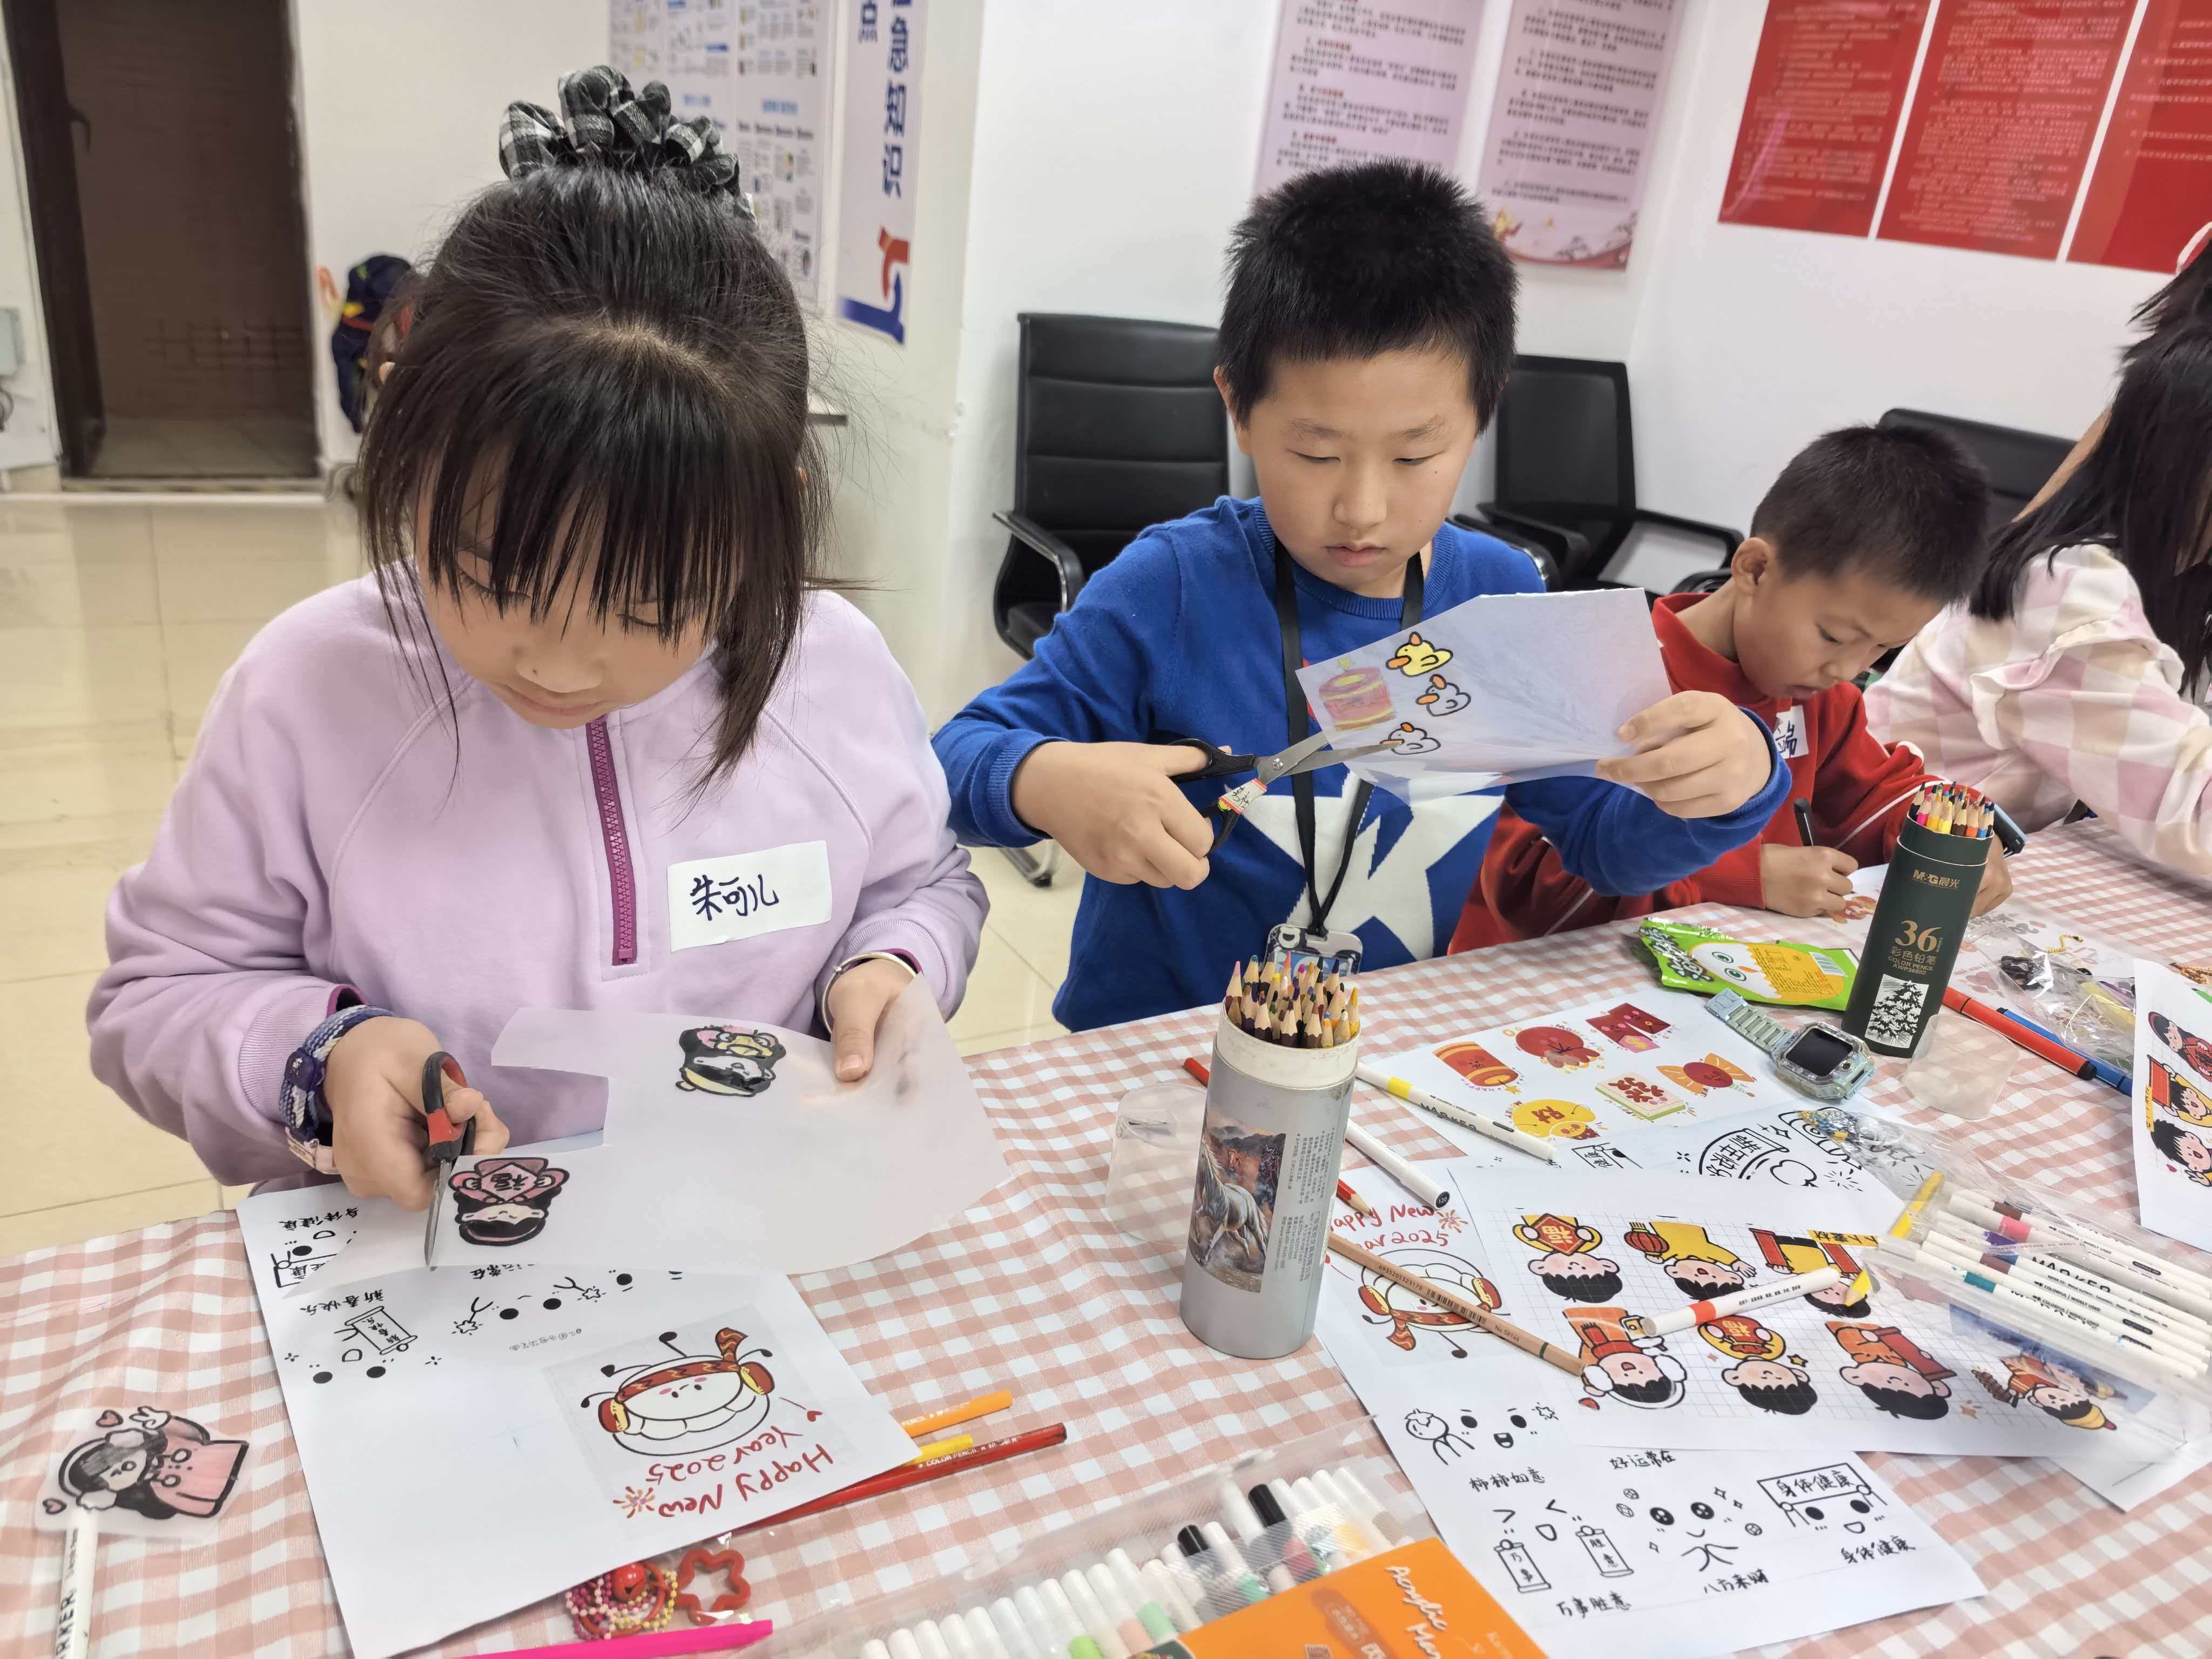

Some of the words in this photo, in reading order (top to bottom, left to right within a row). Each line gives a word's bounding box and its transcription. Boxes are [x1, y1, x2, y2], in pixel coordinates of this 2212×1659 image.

[690, 874, 779, 921] 朱可儿
[1895, 920, 1943, 953] 36
[1887, 955, 1911, 967] COLOR
[1910, 961, 1934, 972] PENCIL
[1890, 945, 1937, 966] 彩色铅笔
[1706, 1135, 1762, 1178] 新年快乐
[490, 1172, 529, 1191] 福
[1439, 1196, 1448, 1204] 120
[278, 1207, 358, 1230] 身体健康
[1331, 1207, 1381, 1232] appy
[1391, 1205, 1434, 1222] New
[1392, 1230, 1448, 1247] 2025
[1541, 1225, 1573, 1244] 福
[470, 1263, 535, 1280] 运常在
[300, 1288, 384, 1316] 新春快乐
[733, 1425, 804, 1464] Year
[926, 1455, 952, 1467] COLOR
[953, 1447, 978, 1459] PENCIL
[645, 1453, 726, 1486] 2025
[735, 1444, 834, 1501] Happy
[1609, 1449, 1676, 1471] 好运常在
[1469, 1467, 1545, 1492] 柿柿如意
[1776, 1470, 1856, 1498] 身体健康
[658, 1483, 723, 1518] New
[1589, 1539, 1618, 1568] 胜意
[1840, 1535, 1917, 1564] 身体健康
[1510, 1552, 1533, 1583] 万事
[1703, 1568, 1770, 1594] 八方来财
[1384, 1564, 1448, 1631] Acrylic
[1556, 1591, 1633, 1618] 万事胜意
